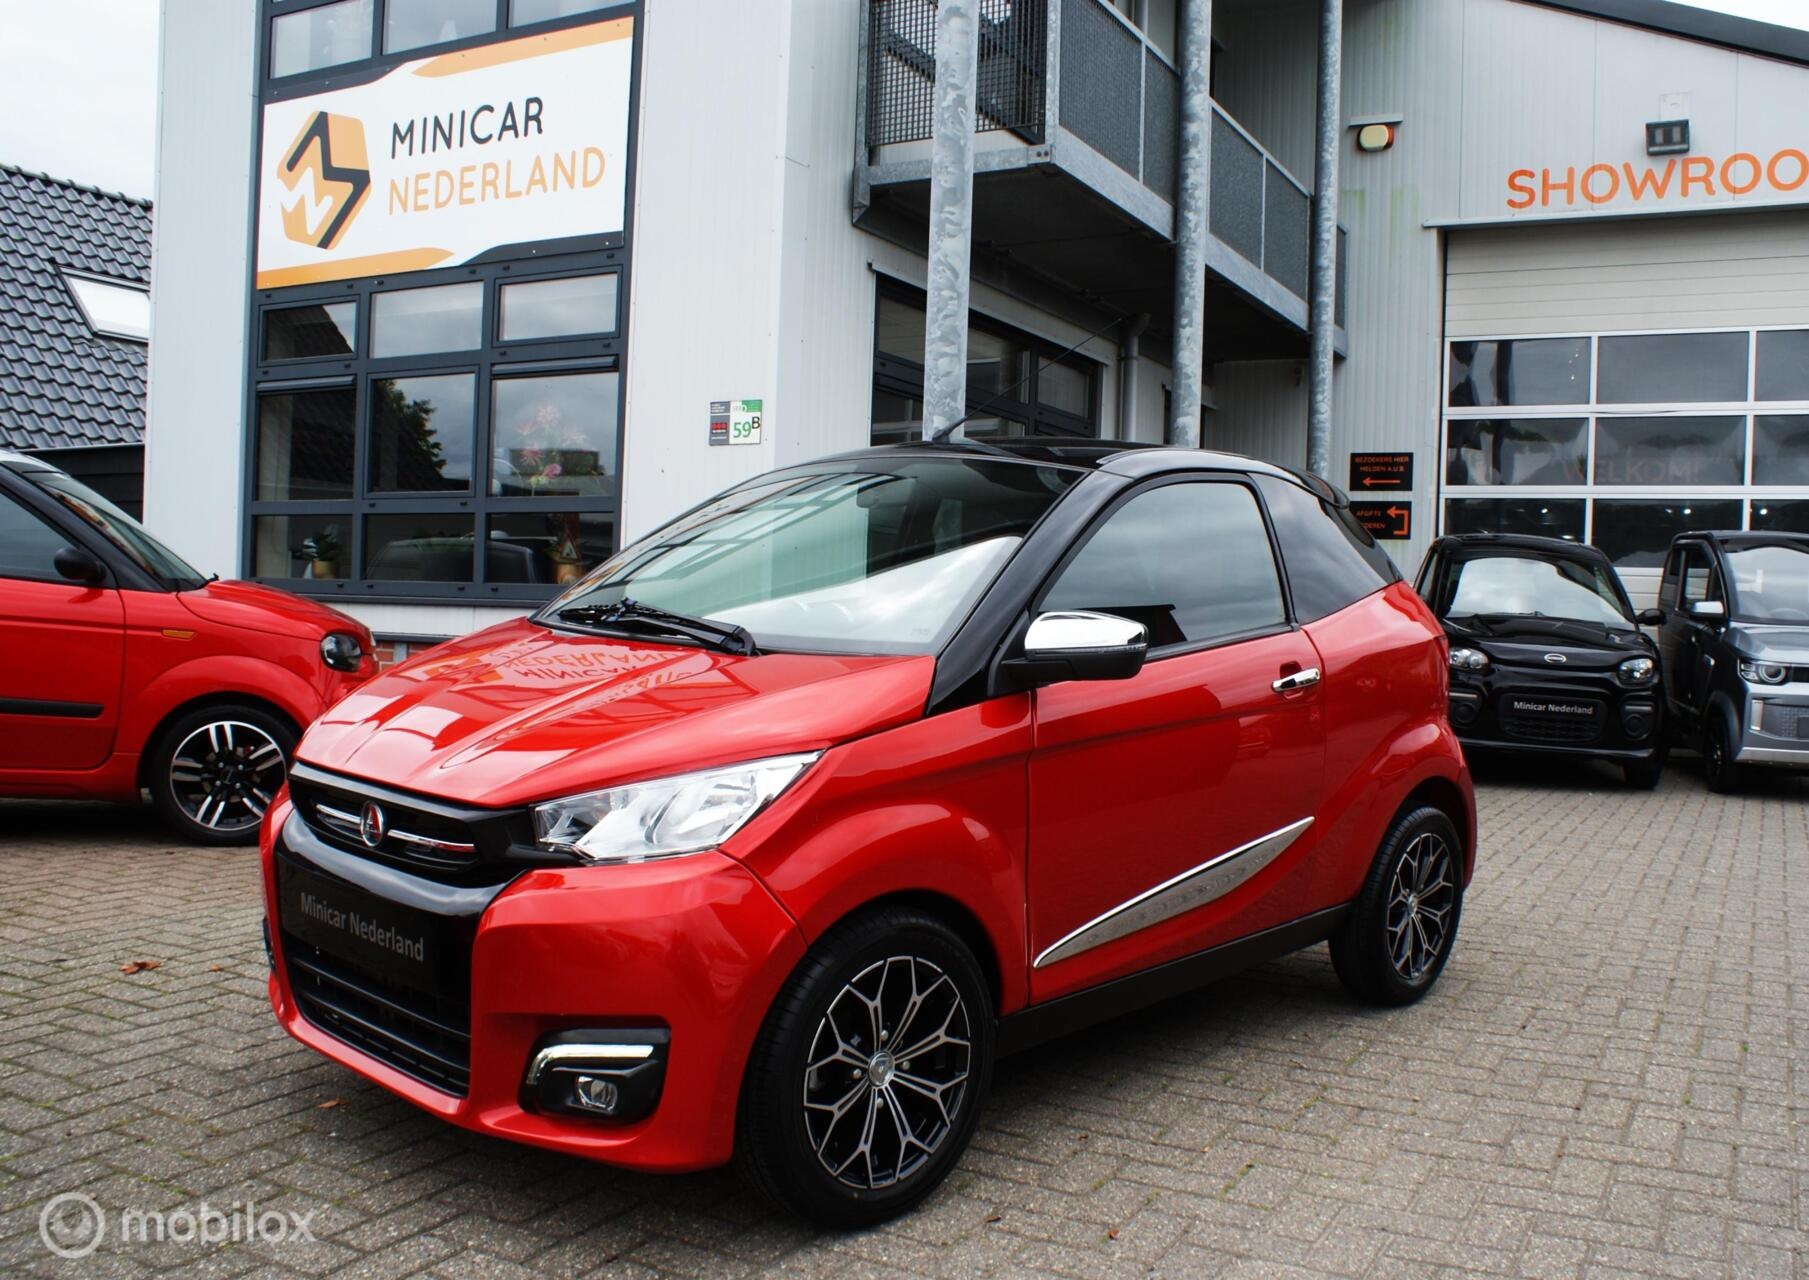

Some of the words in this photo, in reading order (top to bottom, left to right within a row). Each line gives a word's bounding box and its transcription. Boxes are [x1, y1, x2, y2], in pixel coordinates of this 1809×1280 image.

[391, 96, 544, 160] MINICAR
[388, 146, 606, 216] NEDERLAND
[1506, 148, 1809, 209] SHOWROO
[1513, 701, 1546, 711] Minicar
[1548, 703, 1593, 714] Nederland
[300, 892, 346, 930] Minicar
[349, 911, 424, 961] Nederland
